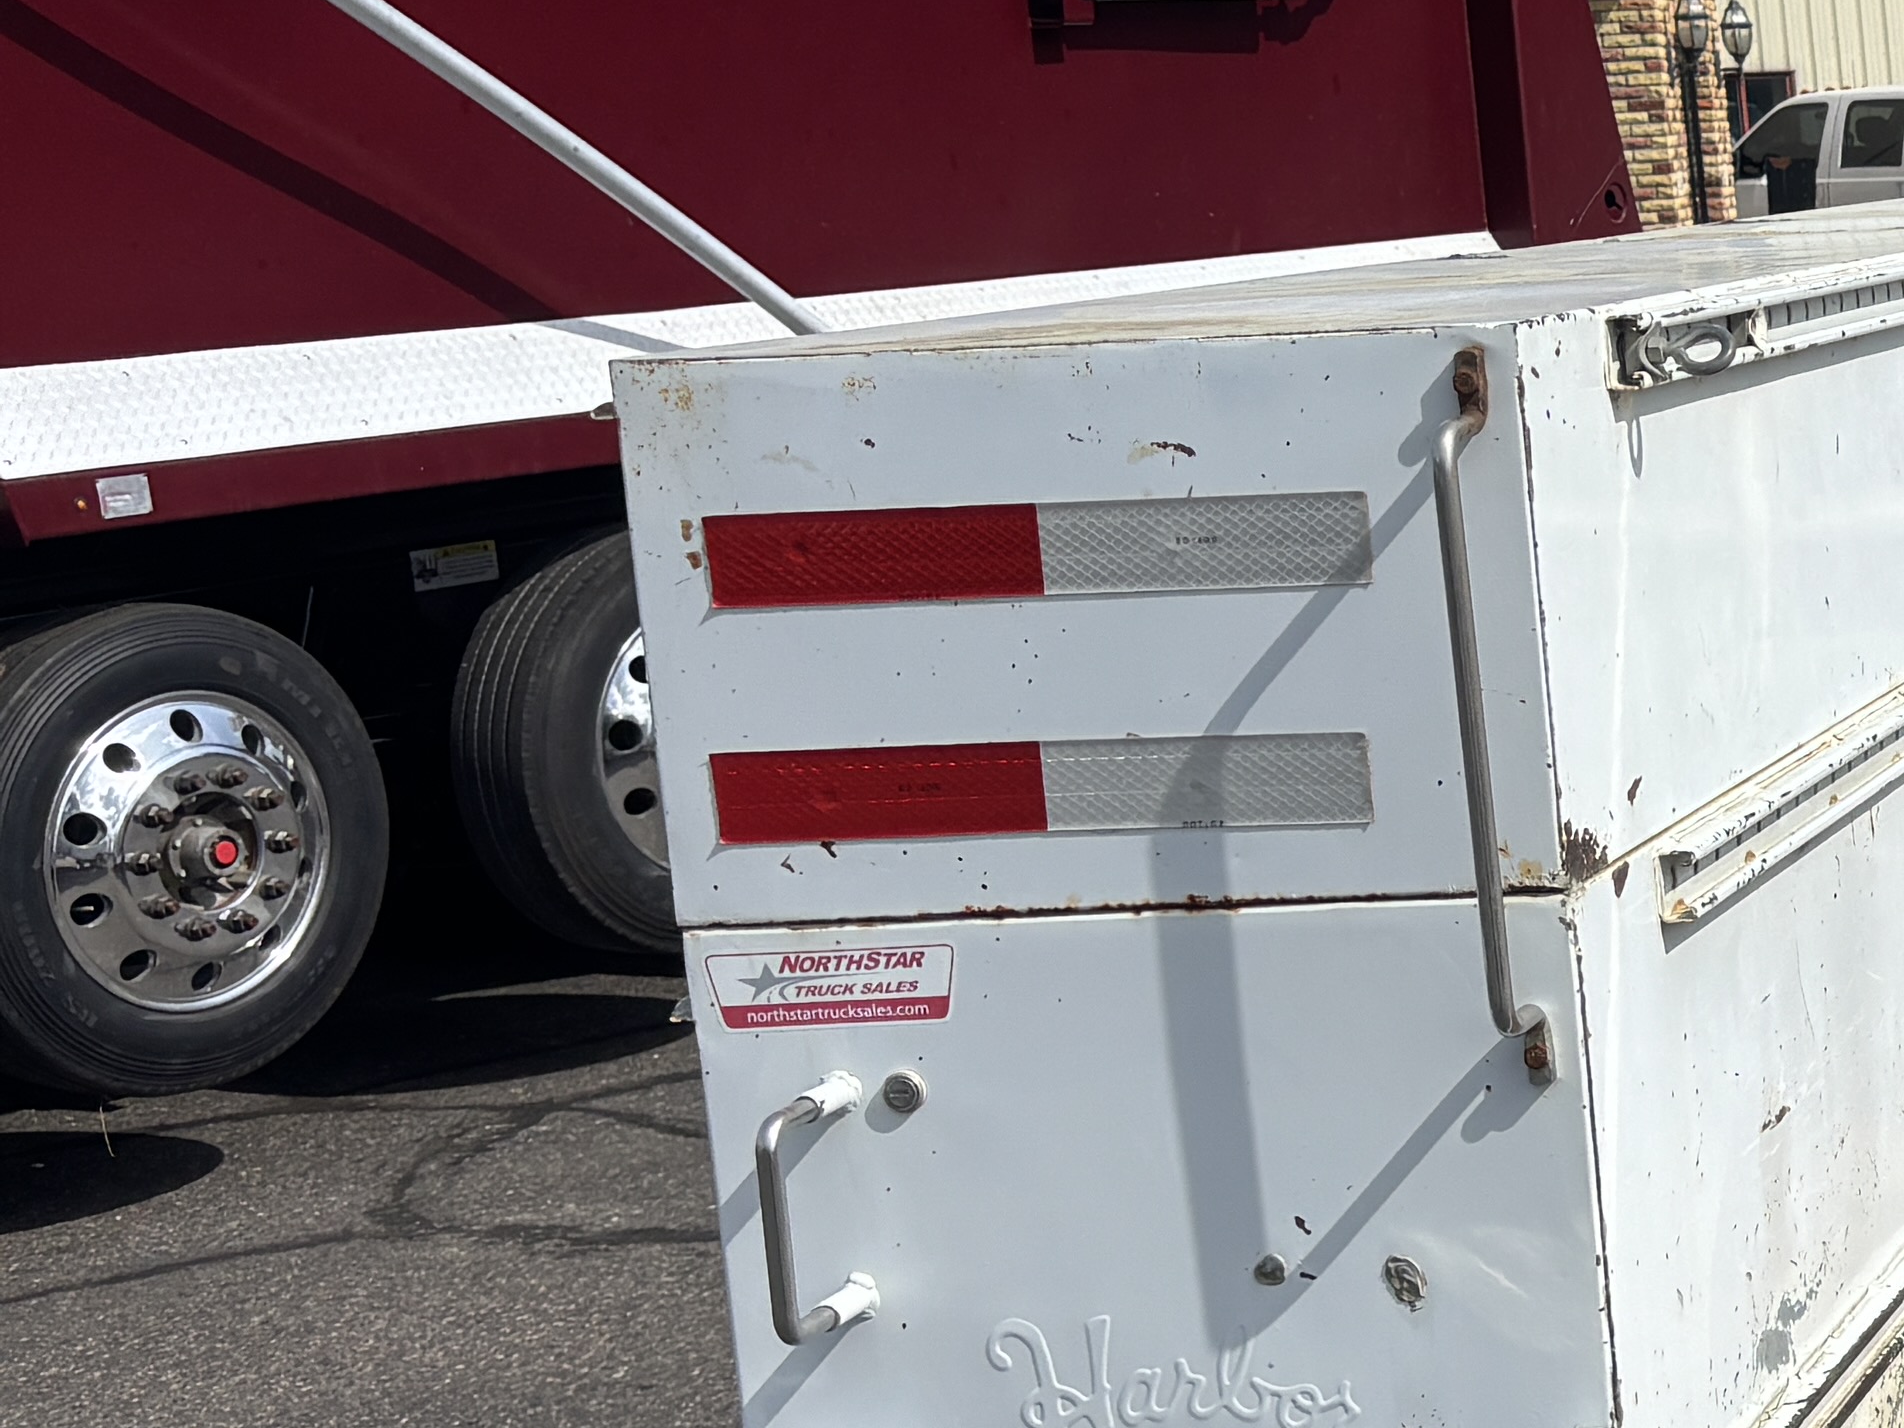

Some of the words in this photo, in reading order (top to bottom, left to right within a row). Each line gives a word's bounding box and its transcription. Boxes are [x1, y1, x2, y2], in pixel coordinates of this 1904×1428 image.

[794, 982, 855, 997] TRUCK
[861, 980, 919, 994] SALES
[747, 1004, 929, 1023] northstartrucksales.com
